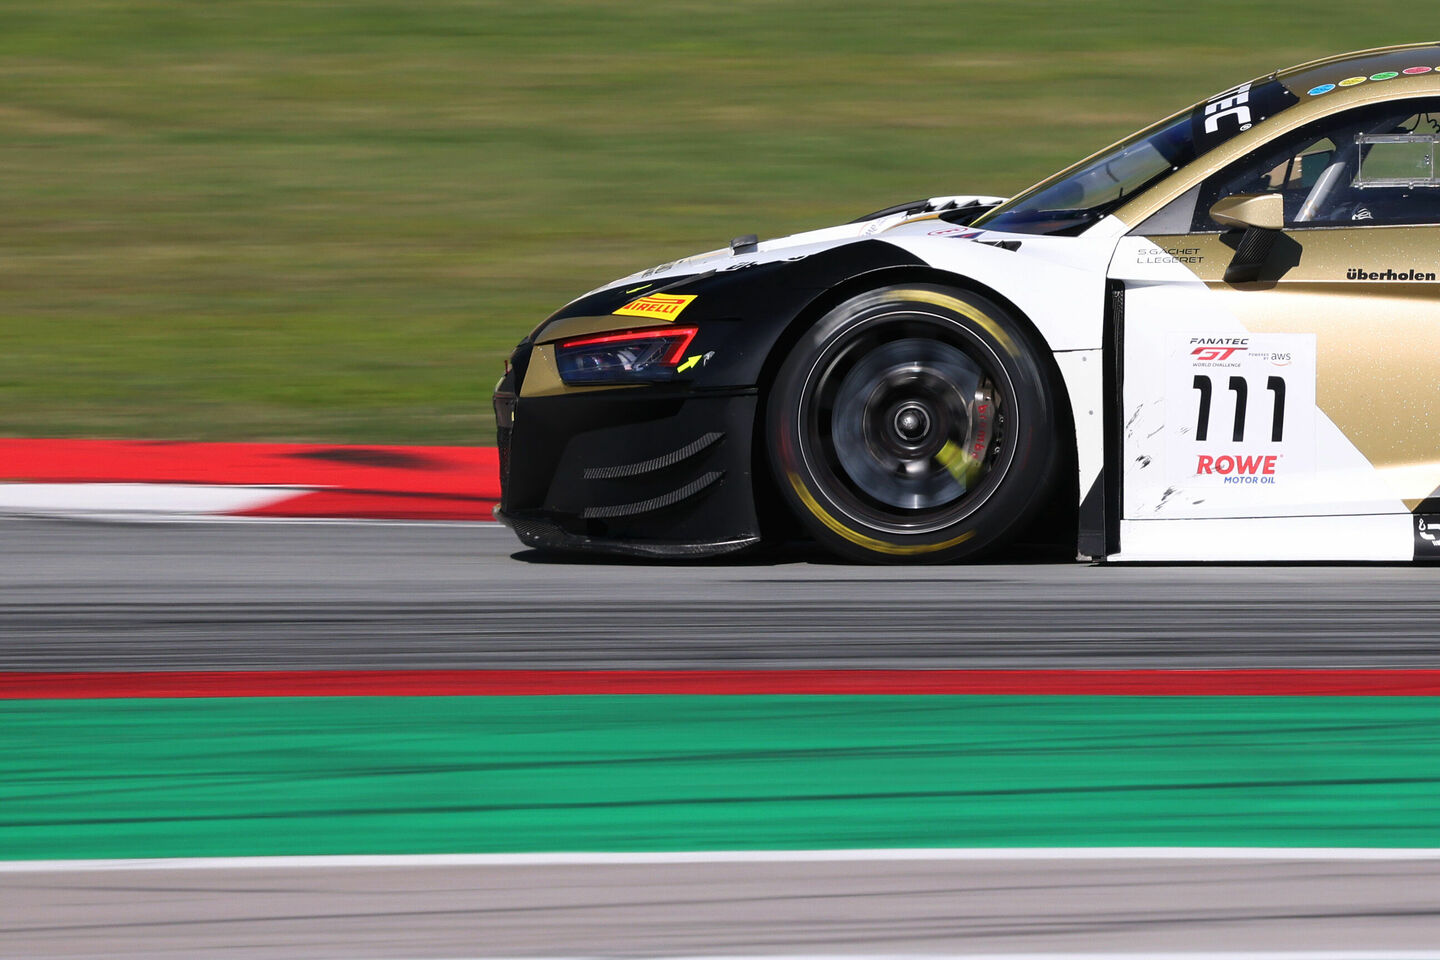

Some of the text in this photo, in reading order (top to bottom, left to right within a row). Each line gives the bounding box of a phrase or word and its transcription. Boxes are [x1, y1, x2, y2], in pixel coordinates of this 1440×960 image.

[1346, 268, 1436, 281] überholen
[622, 296, 687, 314] PIRELLI
[1190, 346, 1249, 361] GT
[1271, 352, 1291, 361] aws
[1193, 375, 1286, 442] 111
[1196, 454, 1278, 475] ROWE
[1223, 476, 1276, 484] MOTOR OIL
